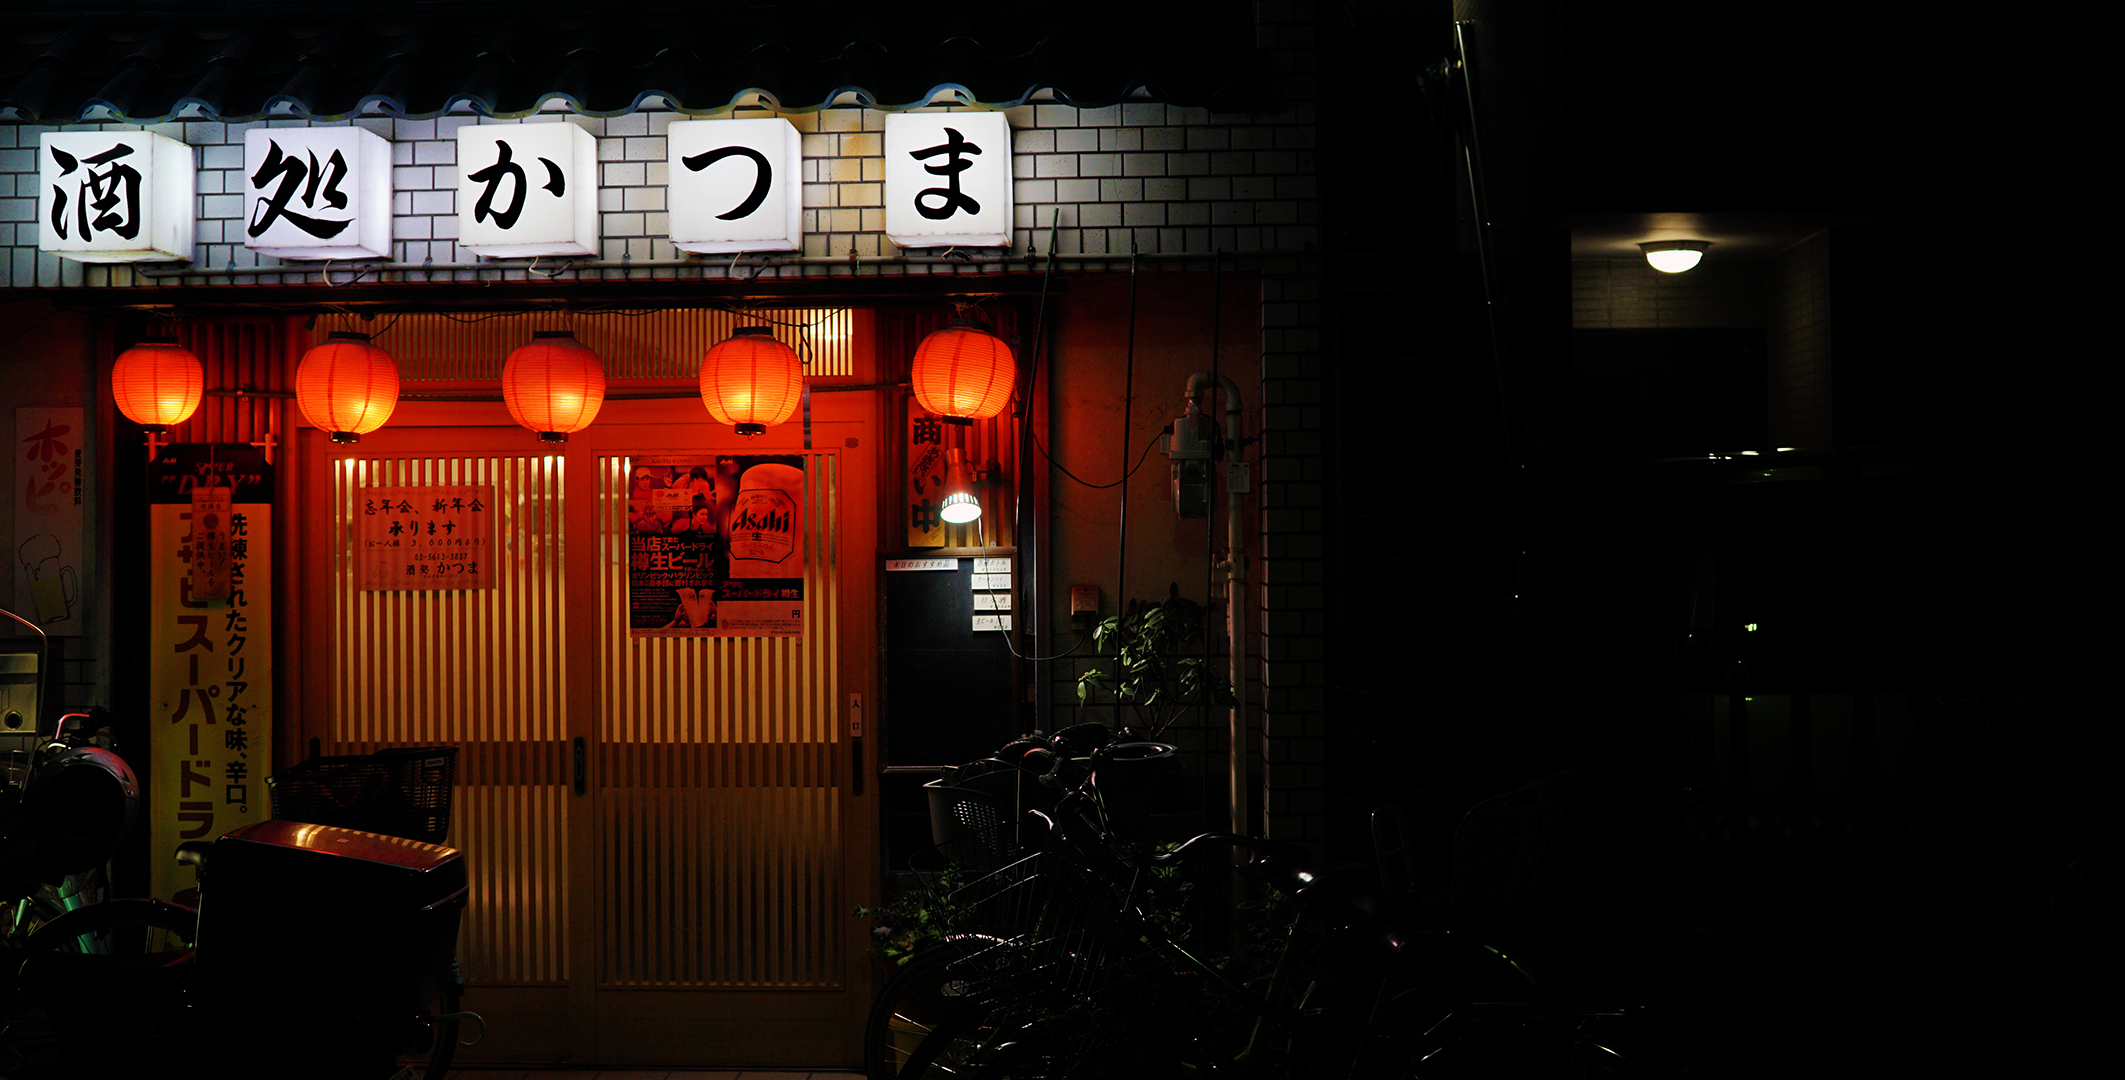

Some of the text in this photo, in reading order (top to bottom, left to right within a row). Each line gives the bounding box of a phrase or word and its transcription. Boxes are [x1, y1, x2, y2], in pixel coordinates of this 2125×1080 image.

[912, 414, 942, 534] 商い中
[365, 498, 485, 515] 忘年会、 新年会
[389, 520, 456, 537] 承ります
[731, 508, 789, 533] Asahi
[631, 536, 662, 552] 当店
[751, 532, 763, 542] 生
[661, 543, 714, 552] スーパードライ
[631, 552, 715, 571] 樽生ビール
[791, 609, 801, 619] 円
